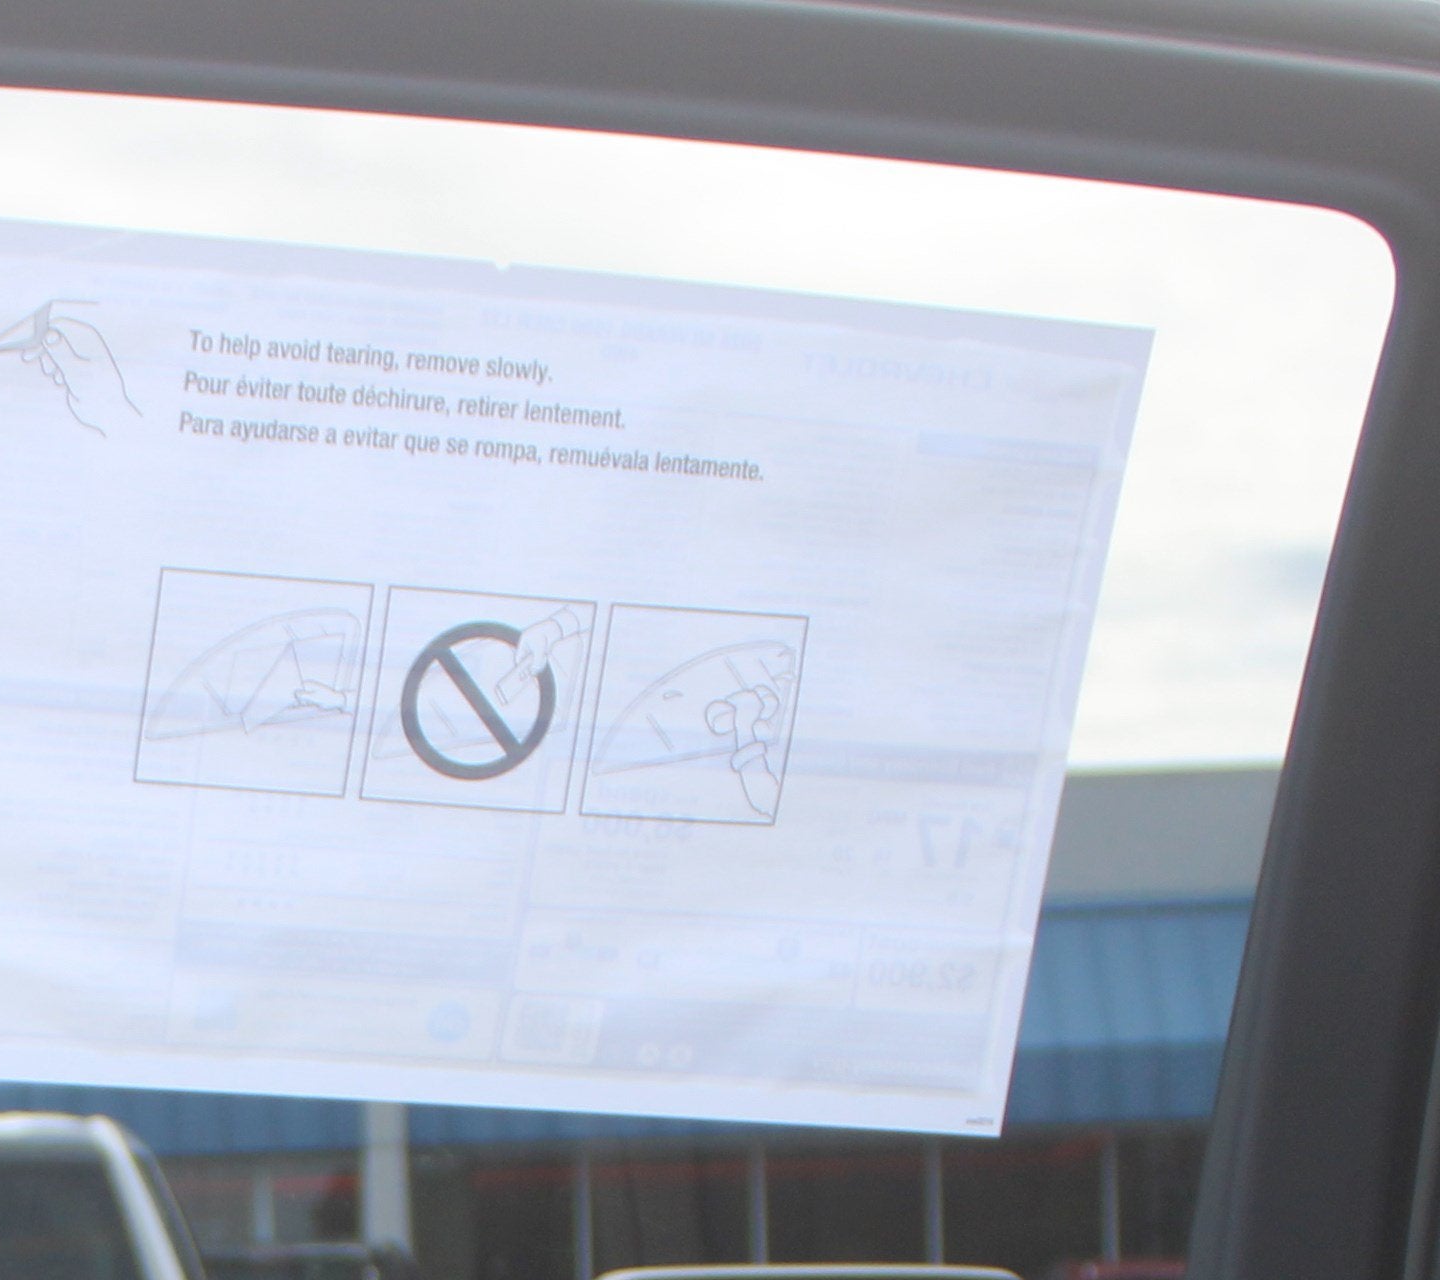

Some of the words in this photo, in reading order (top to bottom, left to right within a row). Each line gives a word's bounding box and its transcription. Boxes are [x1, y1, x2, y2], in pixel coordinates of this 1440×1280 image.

[189, 328, 214, 351] To
[219, 332, 262, 360] help
[267, 338, 321, 362] avoid
[327, 341, 399, 371] tearing,
[406, 351, 480, 376] remove
[485, 355, 553, 385] slowly.
[183, 370, 231, 395] Pour
[235, 373, 293, 400] éviter
[297, 381, 347, 404] toute
[351, 384, 450, 416] déchirure,
[457, 396, 519, 419] retirer
[523, 398, 626, 430] lentement.
[179, 411, 225, 435] Para
[230, 418, 319, 445] ayudarse
[325, 426, 338, 444] a
[342, 426, 399, 449] evitar
[403, 433, 441, 457] que
[446, 435, 470, 455] se
[474, 438, 542, 466] rompa,
[548, 446, 650, 473] remuévala
[654, 451, 764, 482] lentamente.
